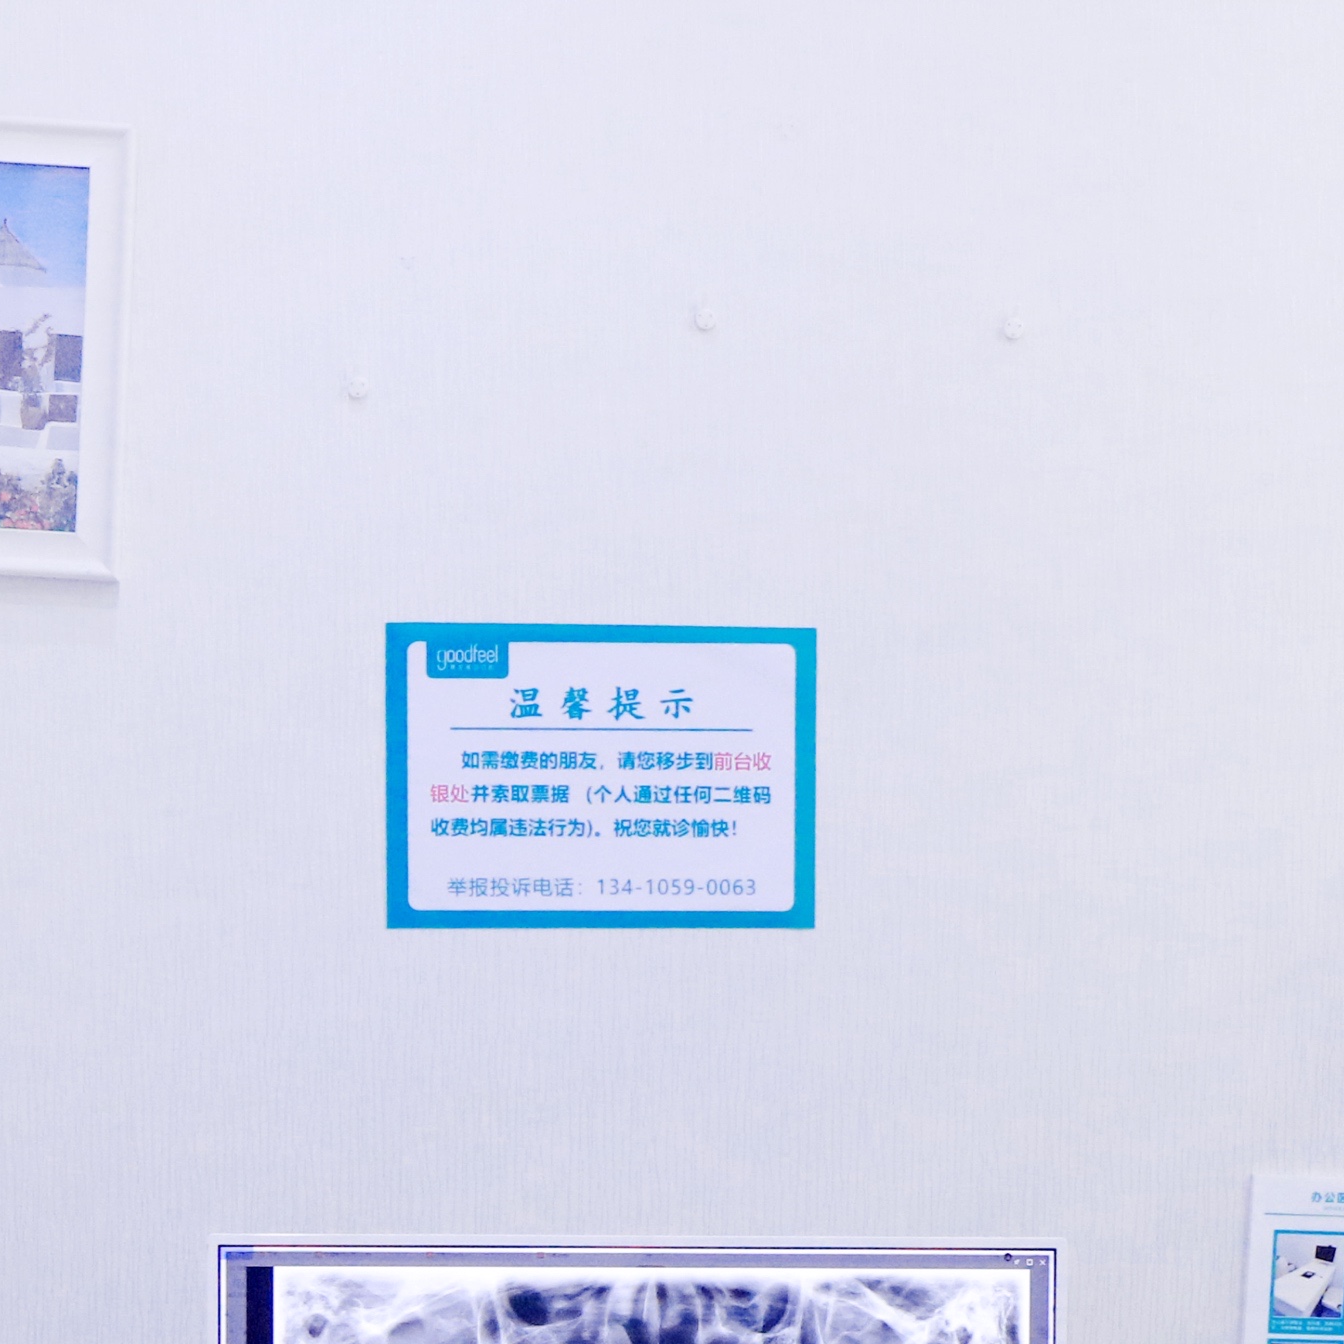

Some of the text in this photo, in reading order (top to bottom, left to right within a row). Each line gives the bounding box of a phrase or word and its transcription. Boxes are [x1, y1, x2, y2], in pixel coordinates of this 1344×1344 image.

[437, 643, 499, 671] goodfeel
[509, 686, 695, 721] 温馨提示
